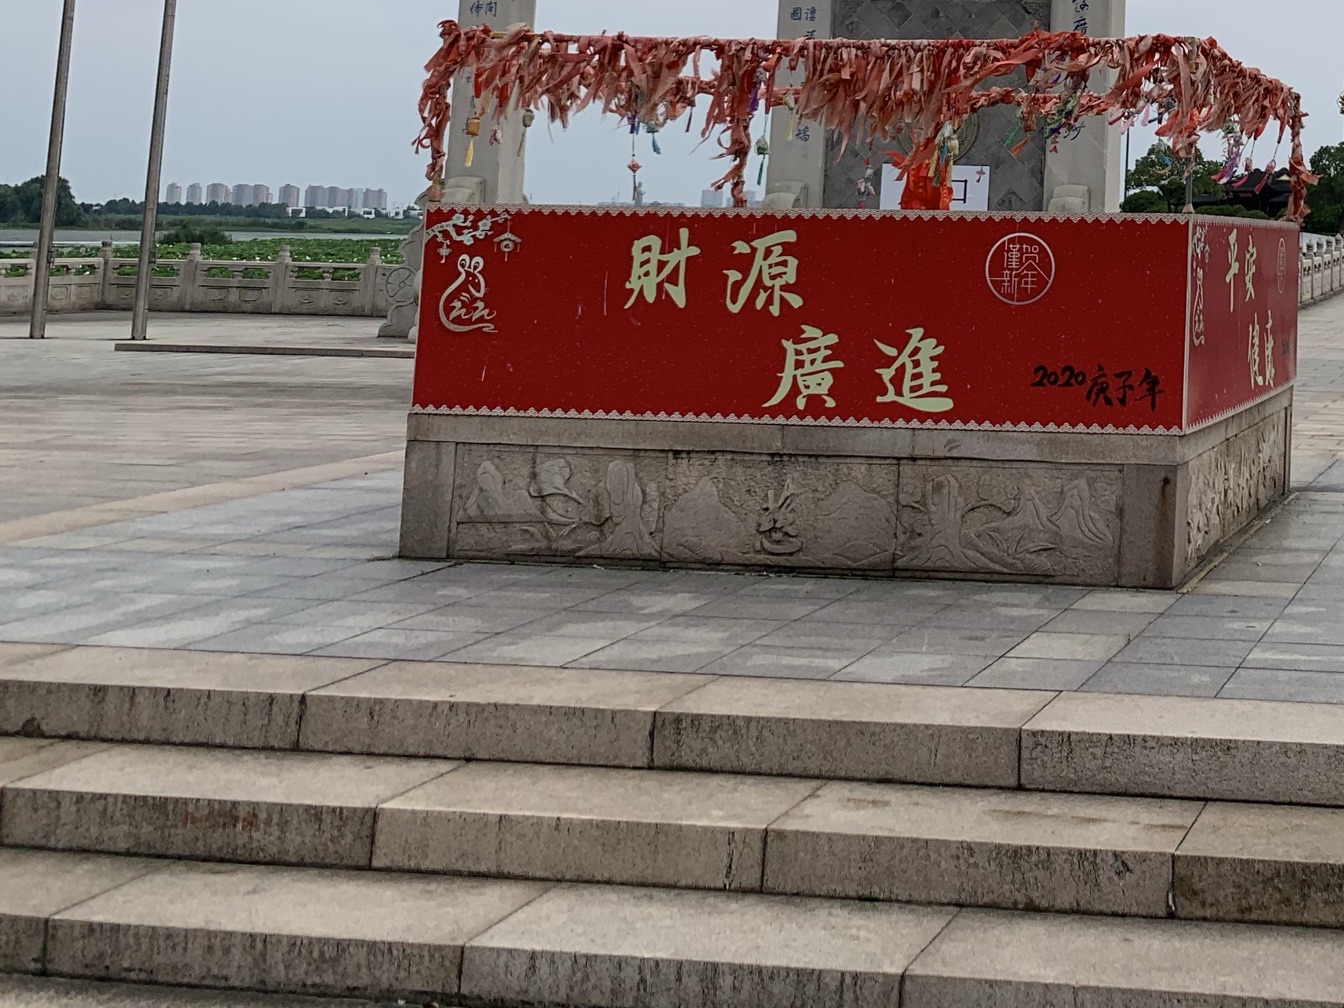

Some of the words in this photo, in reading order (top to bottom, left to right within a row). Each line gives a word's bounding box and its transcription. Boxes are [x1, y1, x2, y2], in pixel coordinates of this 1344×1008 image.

[623, 227, 804, 316] 財源
[1225, 228, 1257, 313] 平安
[761, 324, 954, 412] 廣進
[1247, 309, 1276, 390] 健康
